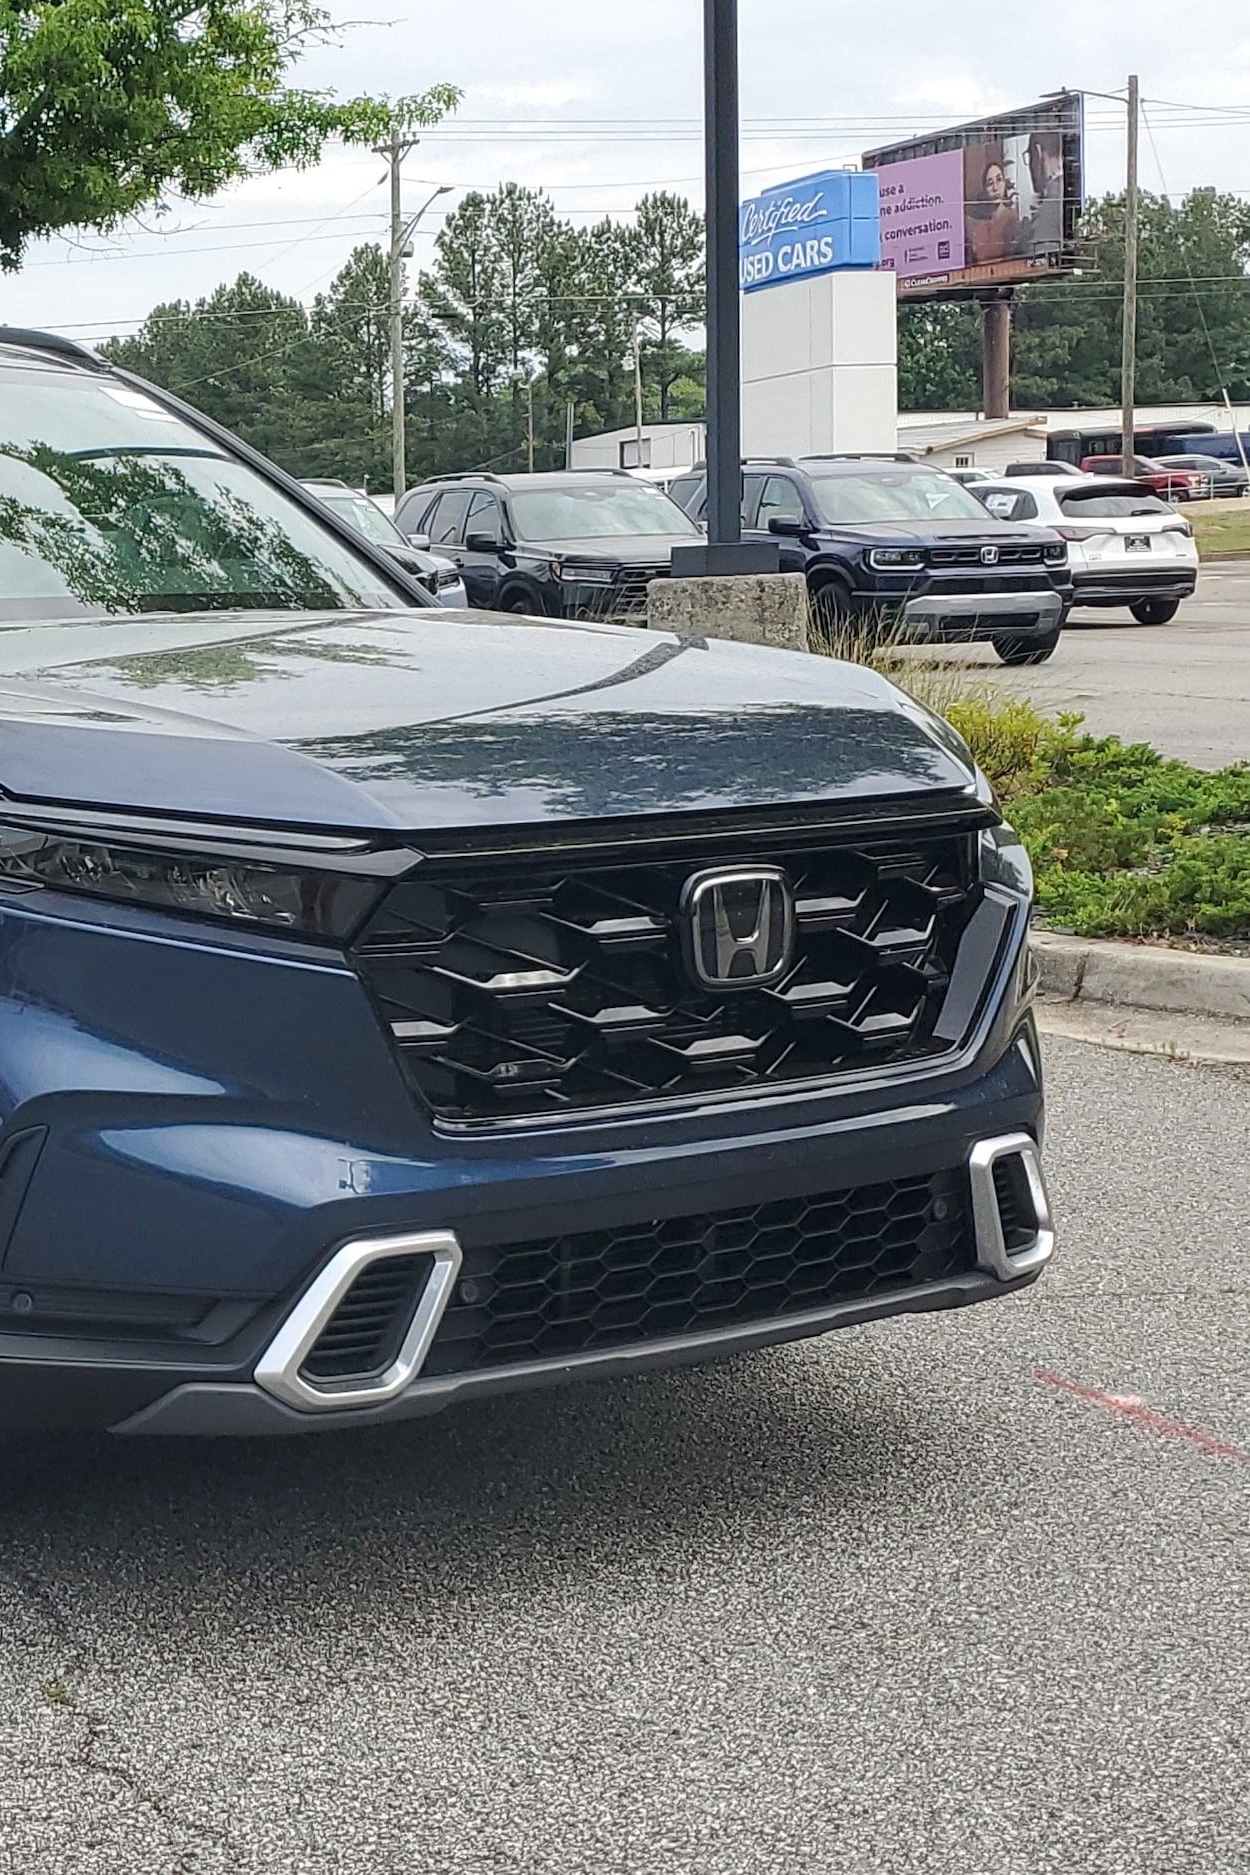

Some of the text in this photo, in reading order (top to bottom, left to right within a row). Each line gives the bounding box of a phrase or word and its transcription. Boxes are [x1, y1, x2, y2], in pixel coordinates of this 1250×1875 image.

[898, 184, 904, 194] a
[894, 195, 944, 213] addiction.
[741, 192, 827, 247] Certified
[885, 219, 953, 240] conversation.
[739, 236, 833, 285] USED CARS
